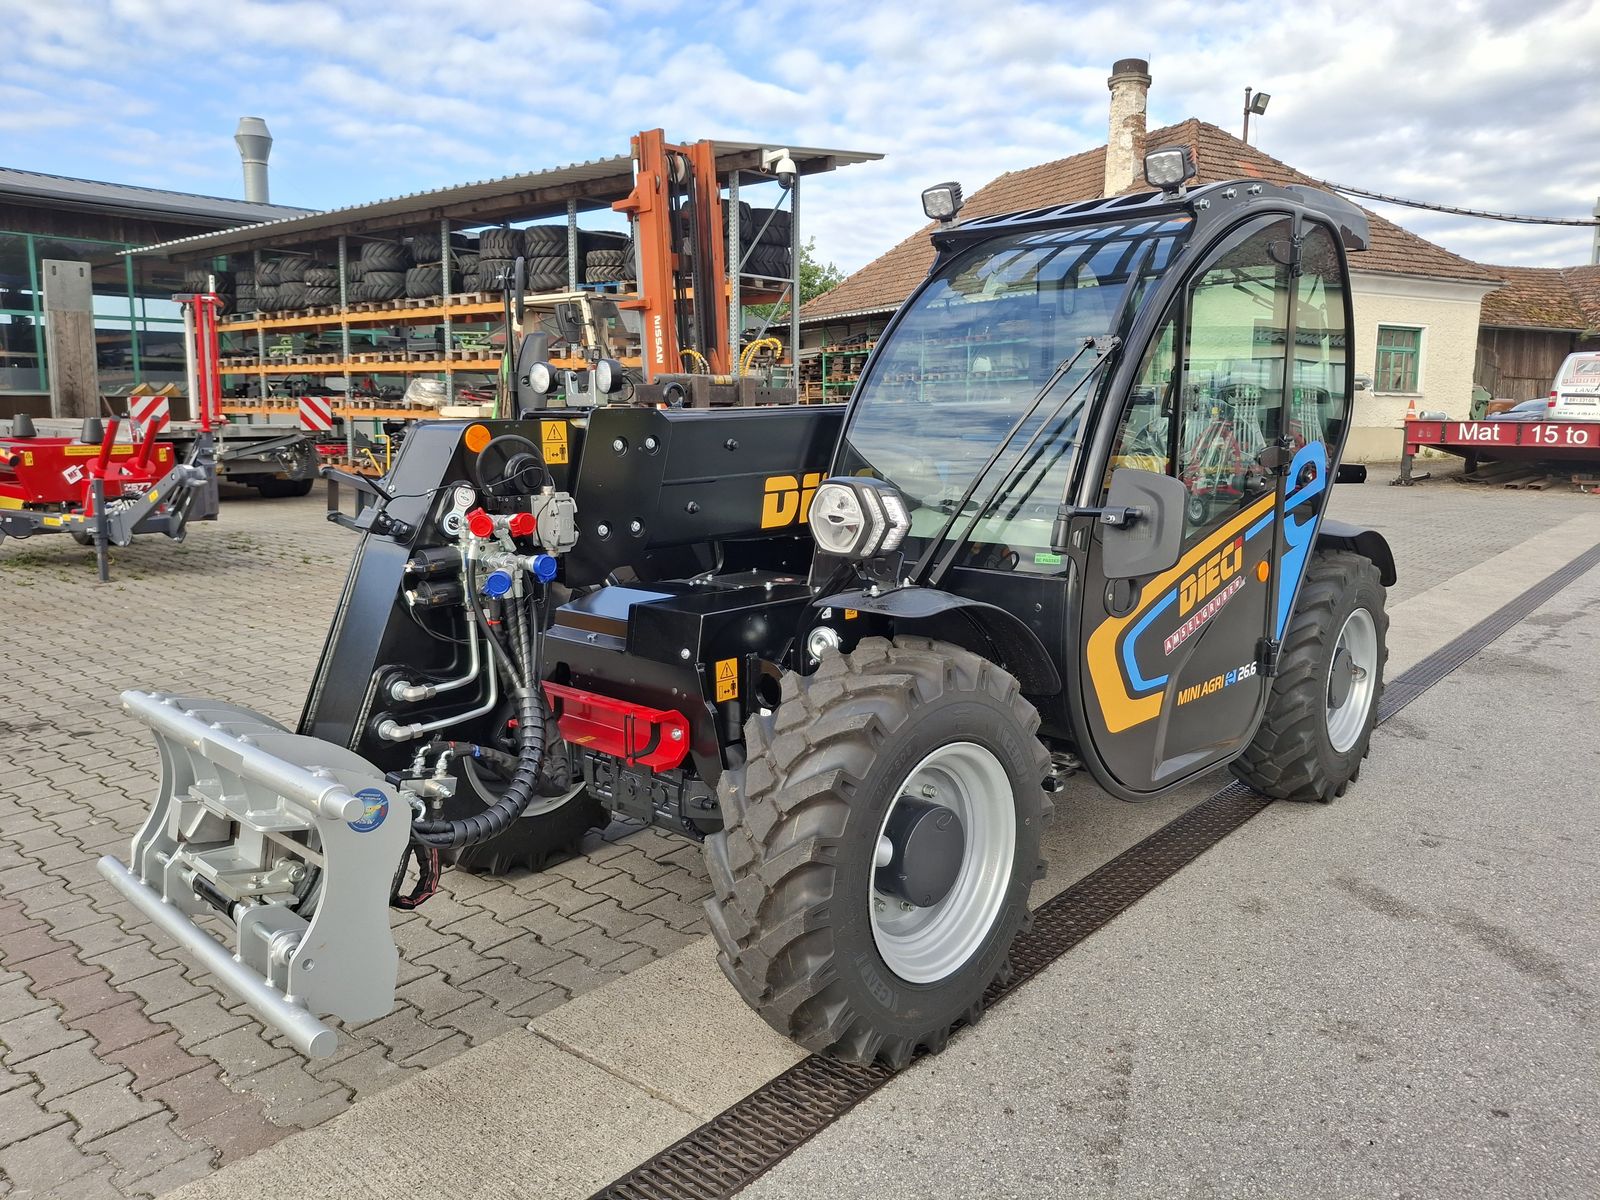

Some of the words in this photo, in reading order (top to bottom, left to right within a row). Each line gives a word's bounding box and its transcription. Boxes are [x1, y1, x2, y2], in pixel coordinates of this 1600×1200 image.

[653, 315, 664, 364] NISSAN
[1458, 423, 1500, 441] Mat
[1532, 425, 1558, 443] 15
[1566, 426, 1588, 444] to
[1165, 578, 1242, 653] AMSELGRUBER
[1177, 683, 1201, 706] MINI
[1201, 675, 1225, 697] AGRI
[1237, 661, 1257, 681] 26.6
